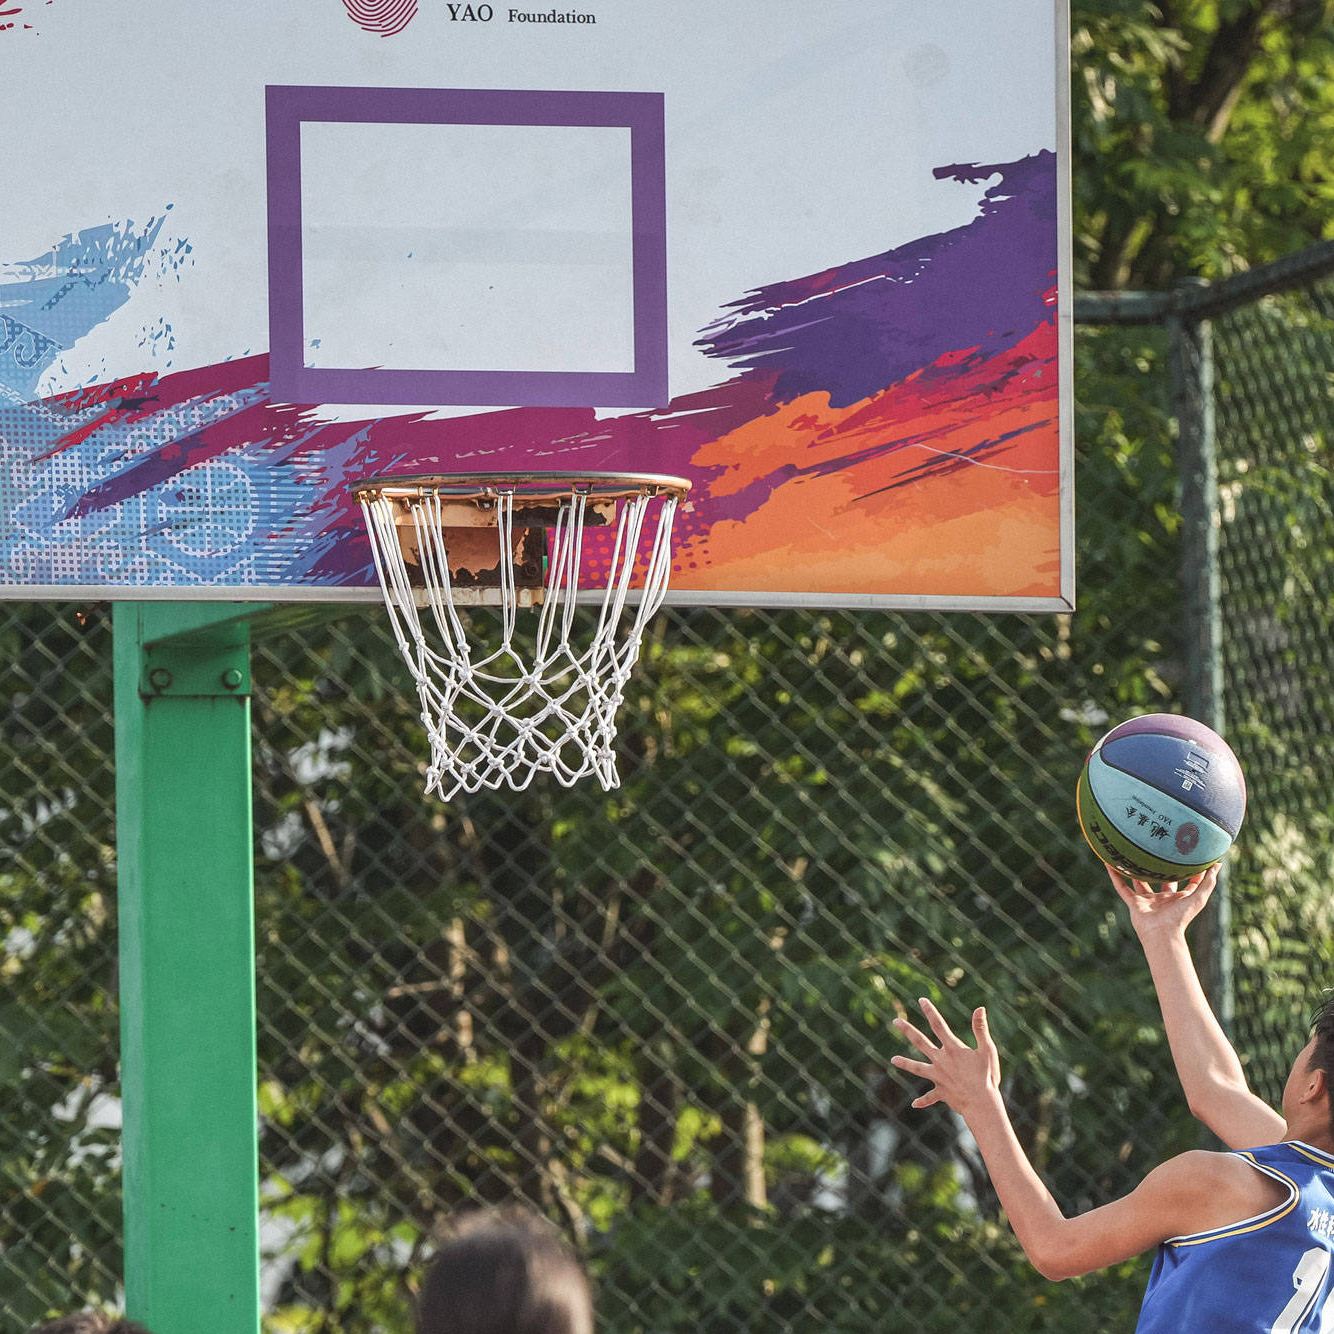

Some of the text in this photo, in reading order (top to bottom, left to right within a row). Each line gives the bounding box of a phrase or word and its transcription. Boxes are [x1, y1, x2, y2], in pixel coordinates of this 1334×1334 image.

[446, 3, 597, 24] YAO Foundation
[1158, 814, 1172, 826] YAO
